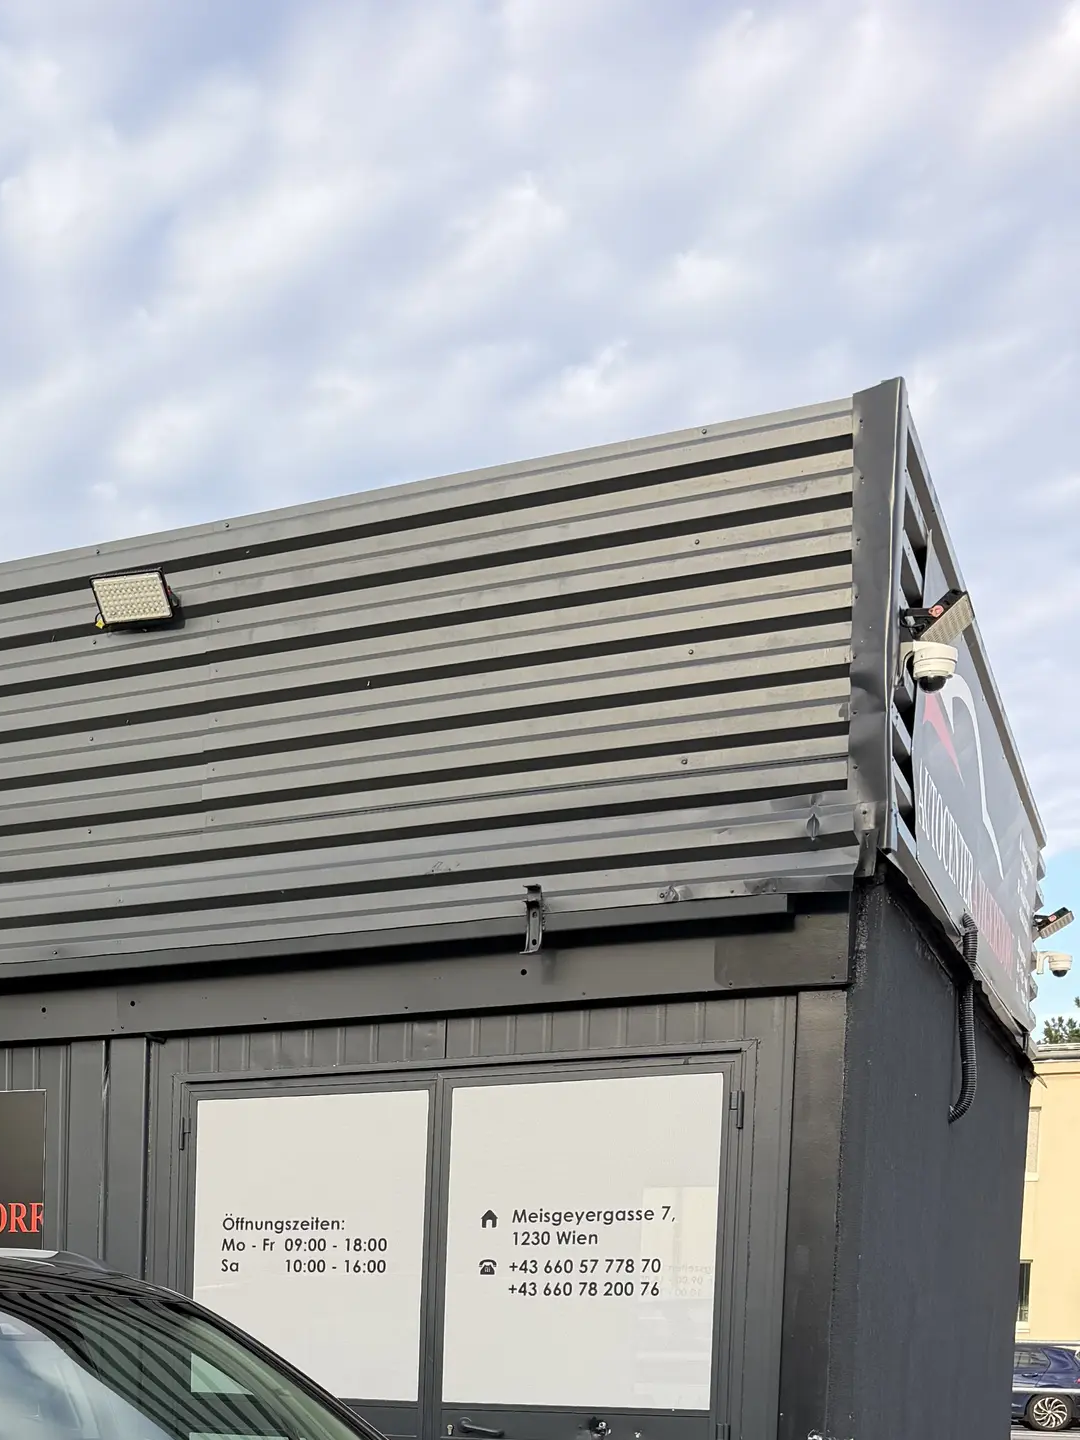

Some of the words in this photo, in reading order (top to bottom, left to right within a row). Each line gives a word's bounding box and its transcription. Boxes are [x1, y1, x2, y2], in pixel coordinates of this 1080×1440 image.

[918, 758, 974, 914] AUTOCENTER
[222, 1213, 345, 1234] Öffnungszeiten:
[511, 1208, 655, 1226] Meisgeyergasse
[661, 1205, 676, 1222] 7,
[221, 1238, 246, 1252] Mo
[262, 1238, 276, 1252] Fr
[284, 1237, 327, 1252] 09:00
[345, 1237, 388, 1252] 18:00
[512, 1231, 551, 1246] 1230
[557, 1230, 598, 1245] Wien
[220, 1258, 240, 1273] Sa
[285, 1259, 326, 1273] 10:00
[344, 1259, 387, 1274] 16:00
[508, 1259, 539, 1274] +43
[543, 1259, 574, 1274] 660
[578, 1259, 599, 1274] 57
[604, 1258, 636, 1273] 778
[641, 1258, 662, 1273] 70
[508, 1282, 538, 1297] +43
[543, 1282, 573, 1297] 660
[578, 1281, 599, 1297] 78
[603, 1281, 635, 1297] 200
[640, 1281, 661, 1297] 76
